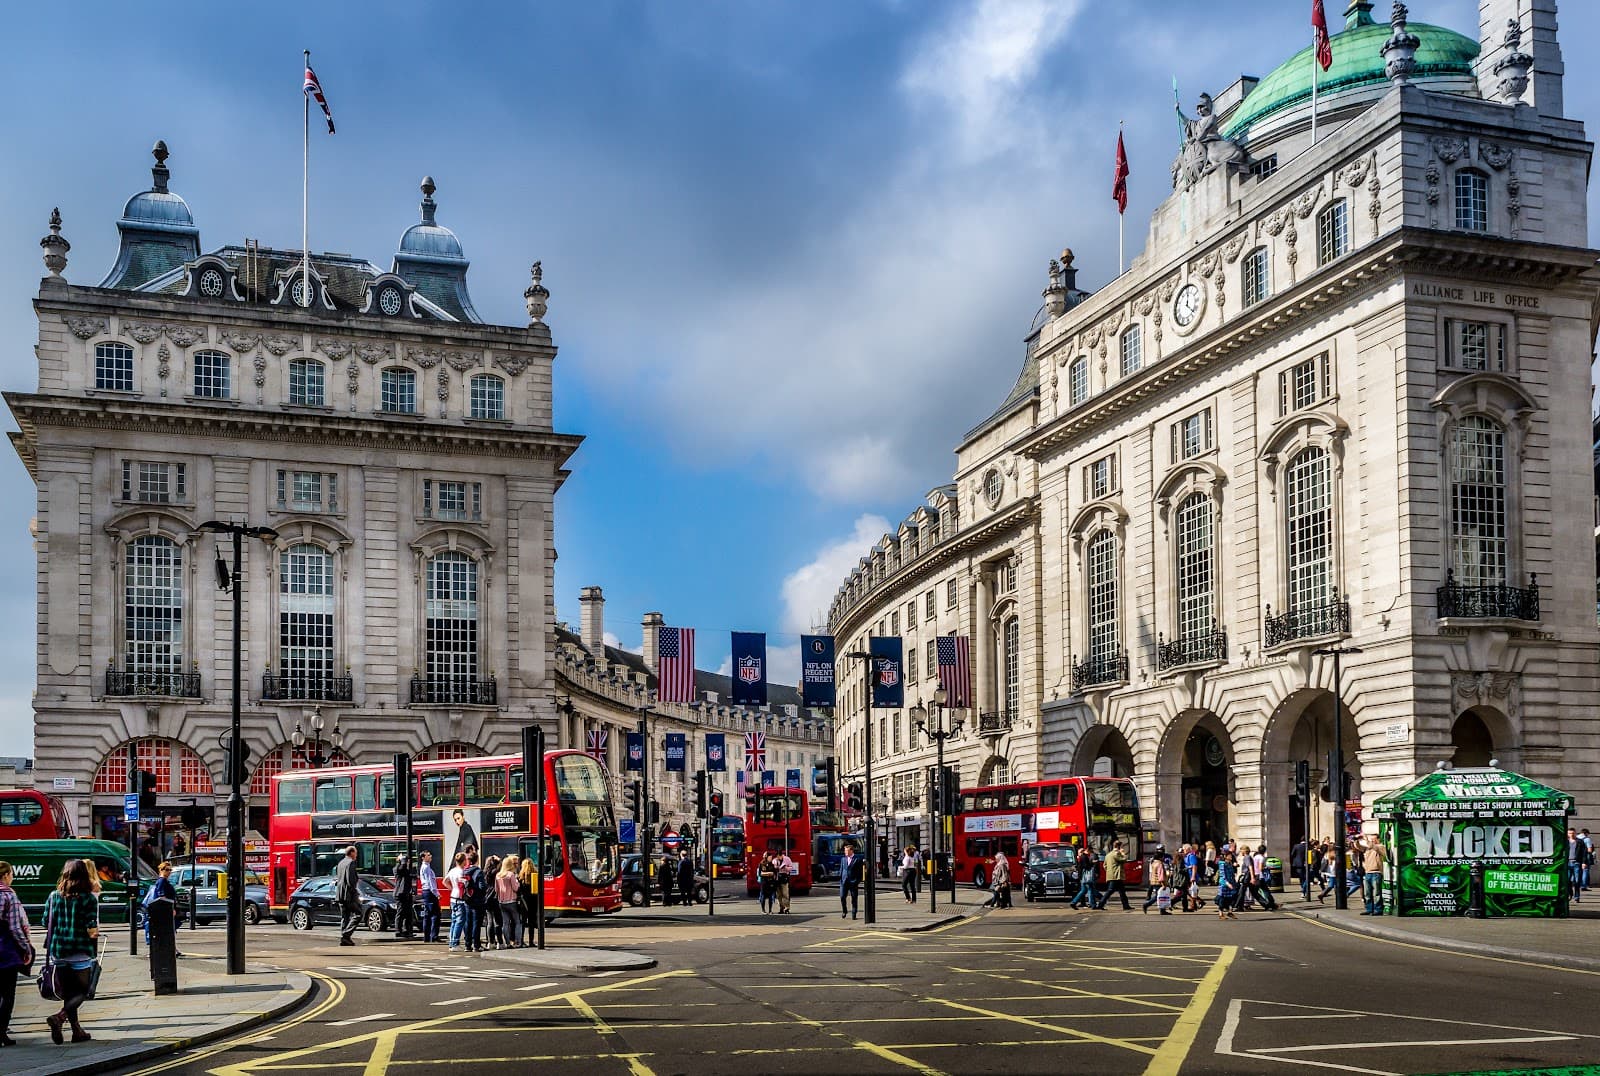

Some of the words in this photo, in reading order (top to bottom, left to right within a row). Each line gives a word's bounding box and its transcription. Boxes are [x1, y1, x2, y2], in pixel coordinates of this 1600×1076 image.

[1412, 284, 1464, 300] ALLIANCE
[1473, 290, 1495, 303] LIFE
[1504, 294, 1540, 308] OFFICE
[742, 668, 758, 679] NFL
[880, 671, 896, 682] NFL
[1491, 801, 1513, 809] SHOW
[1405, 811, 1424, 819] HALF
[1425, 811, 1448, 819] PRICE
[1498, 810, 1521, 818] BOOK
[12, 864, 44, 876] WAY
[1508, 872, 1551, 883] SENSATION
[1487, 880, 1498, 889] OF
